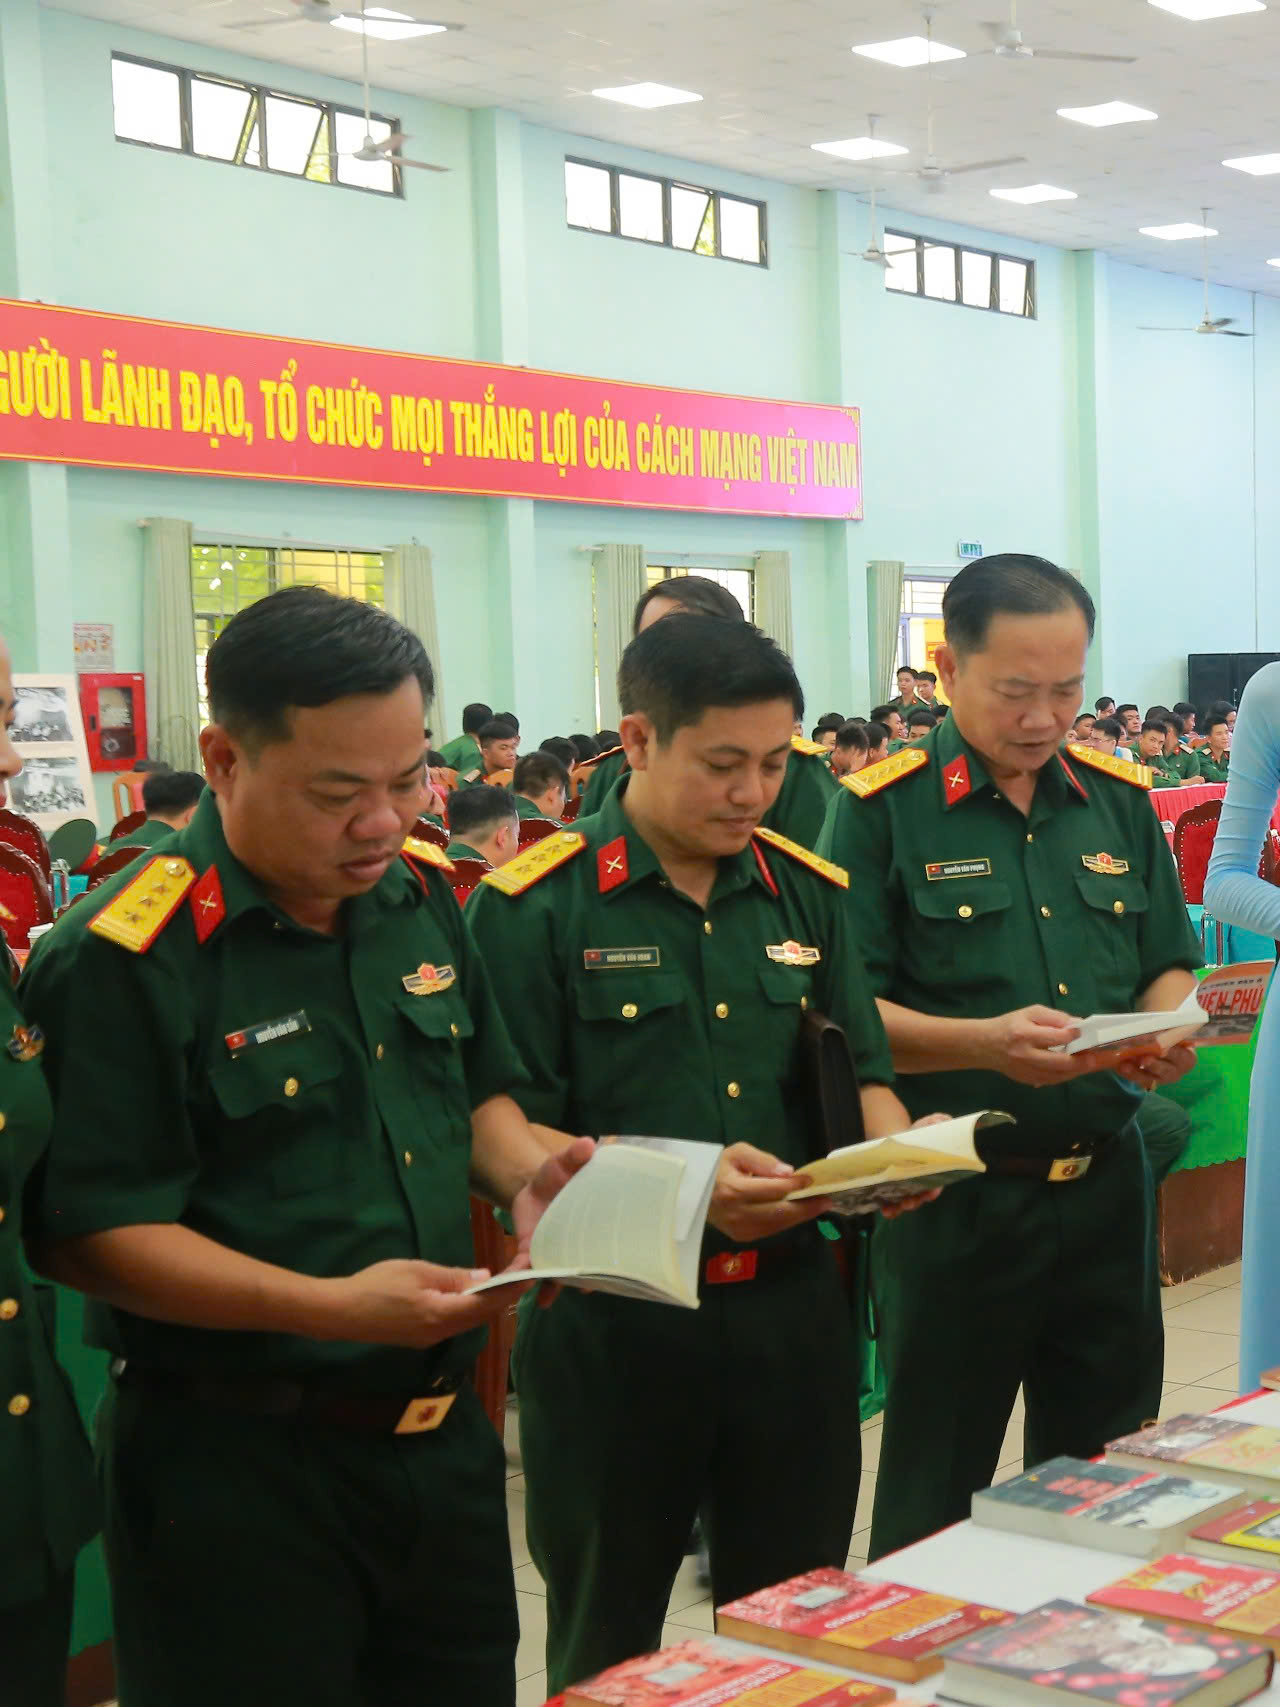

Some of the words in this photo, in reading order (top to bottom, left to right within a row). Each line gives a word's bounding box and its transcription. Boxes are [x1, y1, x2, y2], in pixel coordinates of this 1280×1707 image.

[80, 349, 172, 431] LÃNH
[180, 369, 254, 448] ĐẠO,
[259, 359, 298, 442] TỔ
[306, 378, 383, 450] CHỨC
[391, 394, 444, 466] MỌI
[450, 384, 533, 462] THẮNG
[540, 410, 577, 477] LỢI
[584, 400, 630, 472] CỦA
[636, 413, 694, 477] CÁCH
[700, 429, 761, 490] MẠNG
[767, 428, 808, 495] VIỆT
[813, 440, 858, 489] NAM
